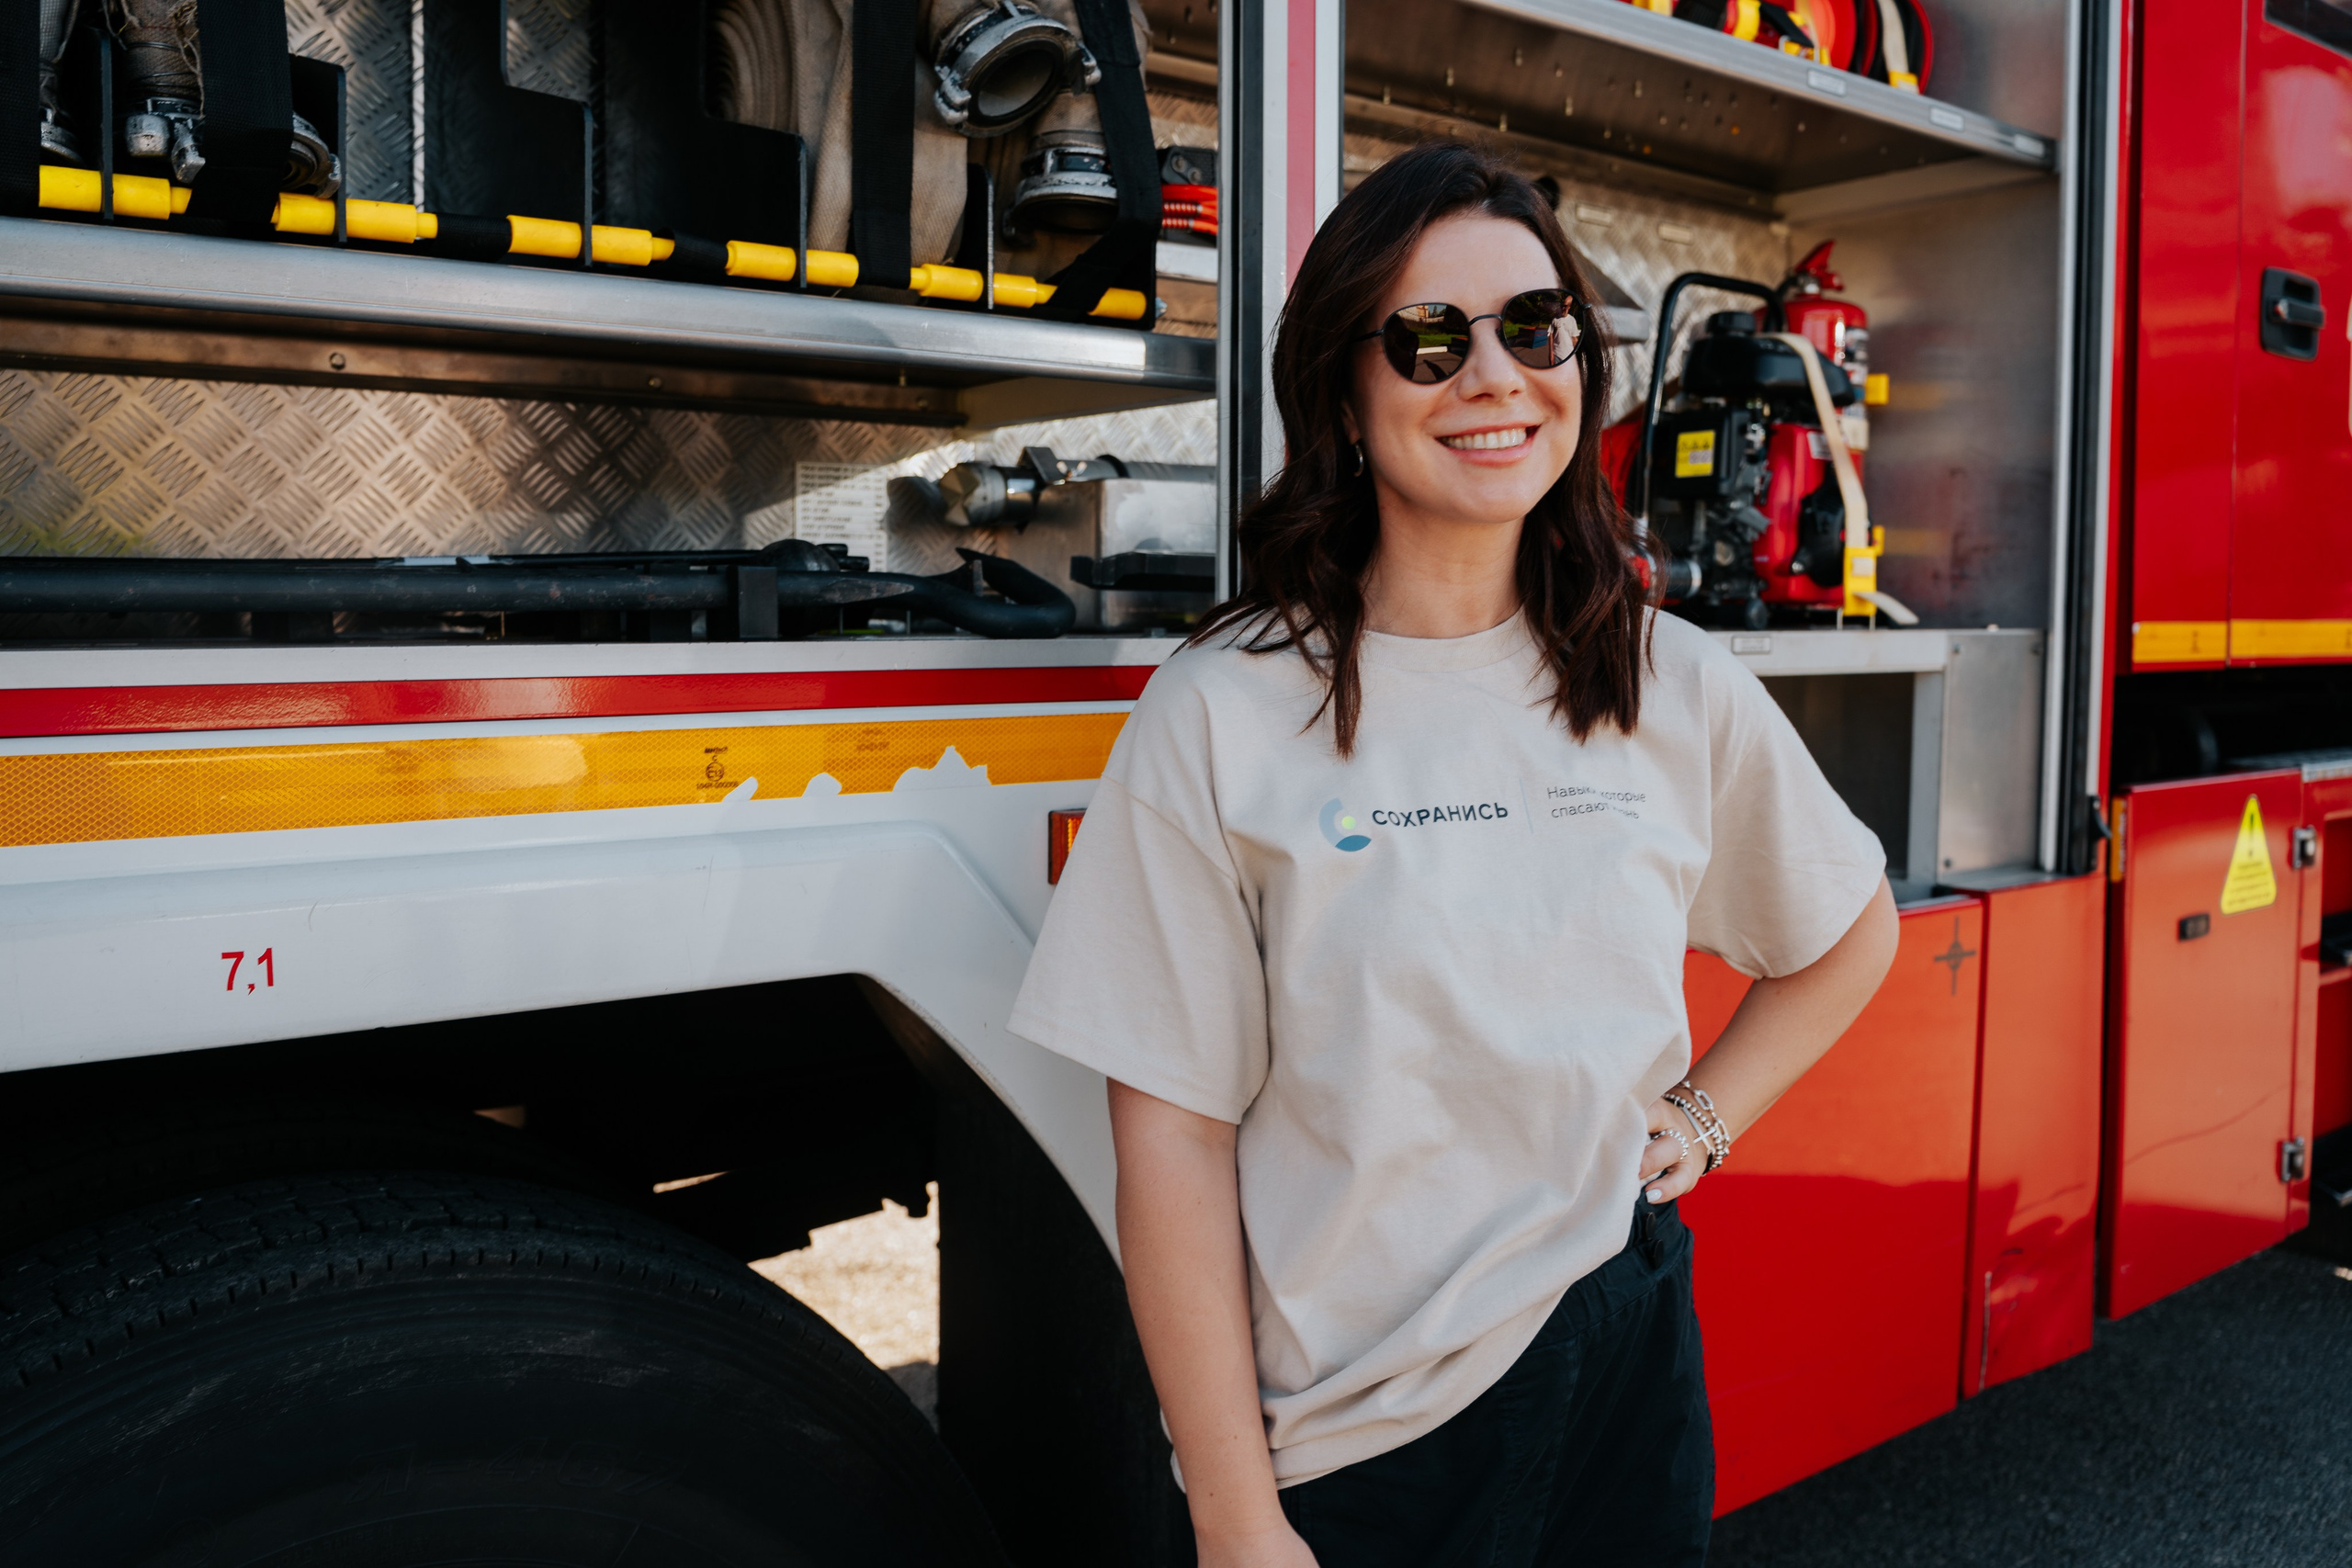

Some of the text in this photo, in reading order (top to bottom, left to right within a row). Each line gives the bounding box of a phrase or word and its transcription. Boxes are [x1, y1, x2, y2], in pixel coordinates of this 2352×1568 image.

[1546, 785, 1596, 800] Навык
[1372, 802, 1509, 828] СОХРАНИСЬ
[220, 947, 275, 996] 7,1
